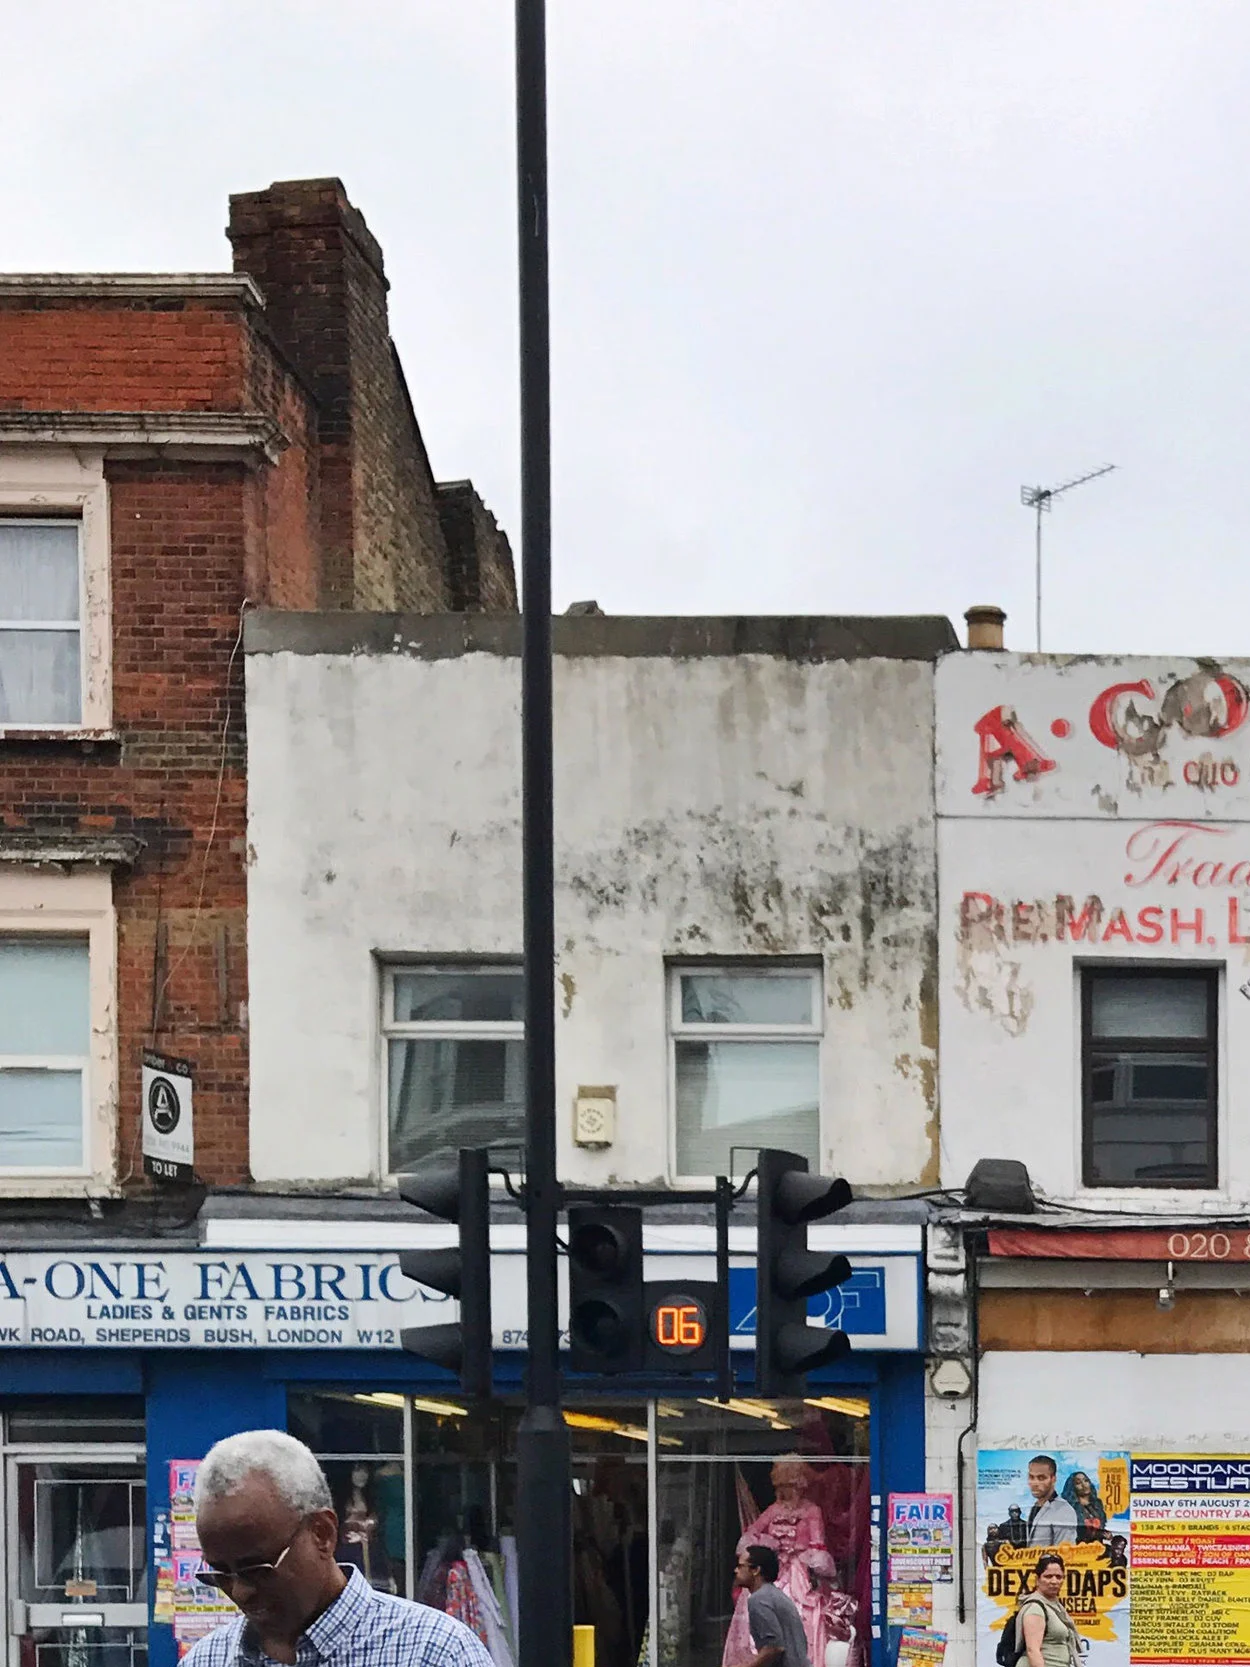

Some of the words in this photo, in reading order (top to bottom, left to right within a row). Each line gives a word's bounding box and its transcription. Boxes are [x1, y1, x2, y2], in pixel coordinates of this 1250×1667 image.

[151, 1160, 162, 1175] TO
[164, 1163, 178, 1178] LET
[1167, 1233, 1230, 1258] 020
[0, 1261, 170, 1302] A-ONE
[87, 1304, 153, 1320] LADIES
[162, 1304, 175, 1320] &
[184, 1304, 248, 1320] GENTS
[264, 1305, 350, 1322] FABRICS
[656, 1306, 703, 1345] 06
[31, 1327, 86, 1345] ROAD,
[96, 1328, 191, 1343] SHEPERDS
[204, 1328, 258, 1345] BUSH,
[267, 1329, 343, 1344] LONDON
[357, 1329, 396, 1344] W12
[1106, 1485, 1121, 1505] 20
[1133, 1499, 1174, 1507] SUNDAY
[1178, 1499, 1196, 1507] 6TH
[1200, 1499, 1240, 1507] AUGUST
[895, 1505, 946, 1521] FAIR
[1134, 1509, 1171, 1518] TRENT
[1175, 1509, 1230, 1518] COUNTRY
[1067, 1569, 1127, 1597] DAPS
